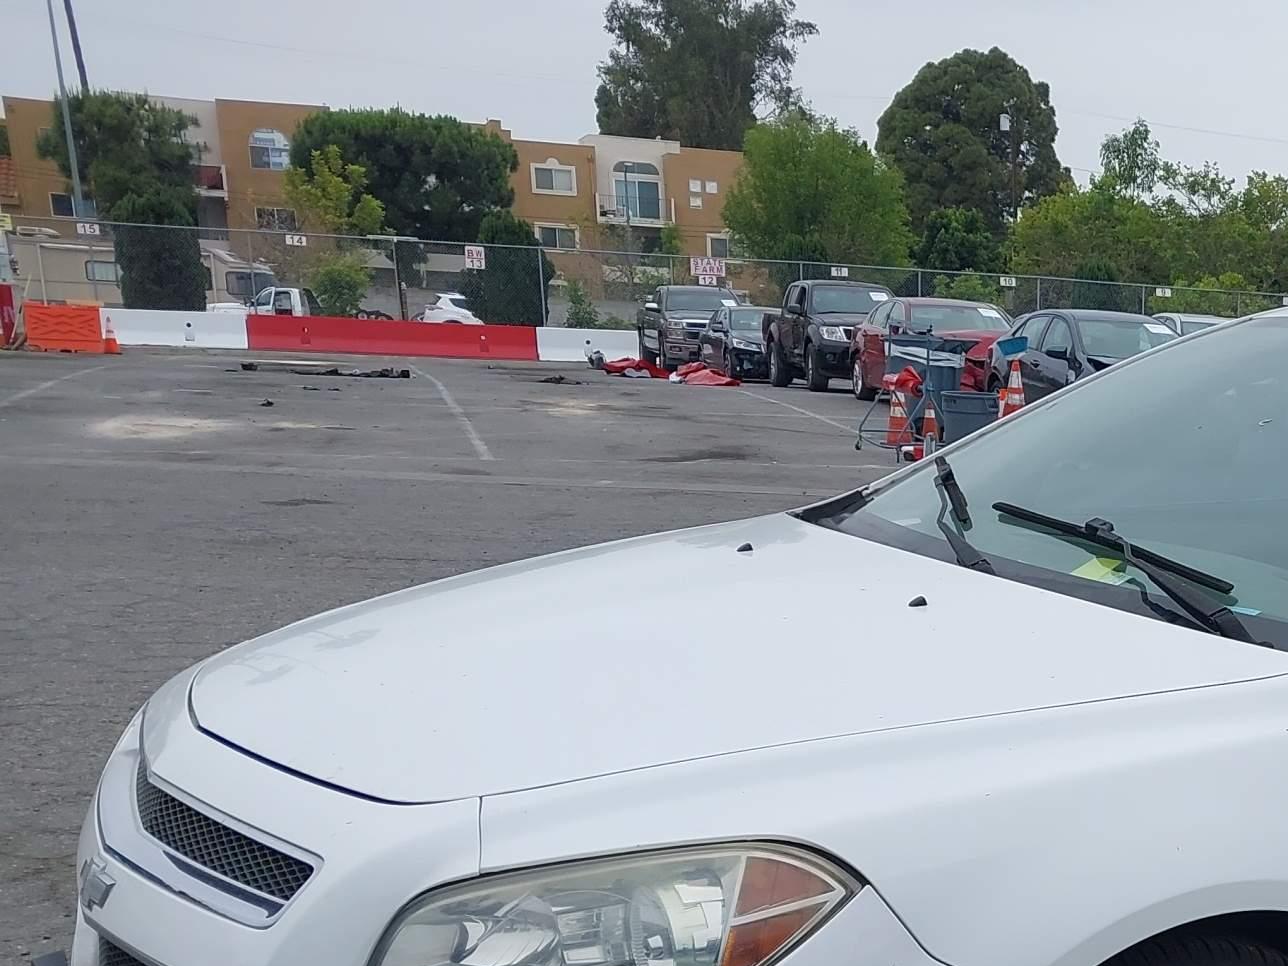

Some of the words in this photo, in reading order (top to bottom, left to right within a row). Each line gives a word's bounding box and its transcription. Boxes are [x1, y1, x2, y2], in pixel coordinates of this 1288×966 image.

[80, 224, 96, 234] 15
[289, 236, 303, 246] 14
[470, 260, 483, 268] 13
[695, 266, 723, 274] FARM
[700, 276, 714, 285] 12
